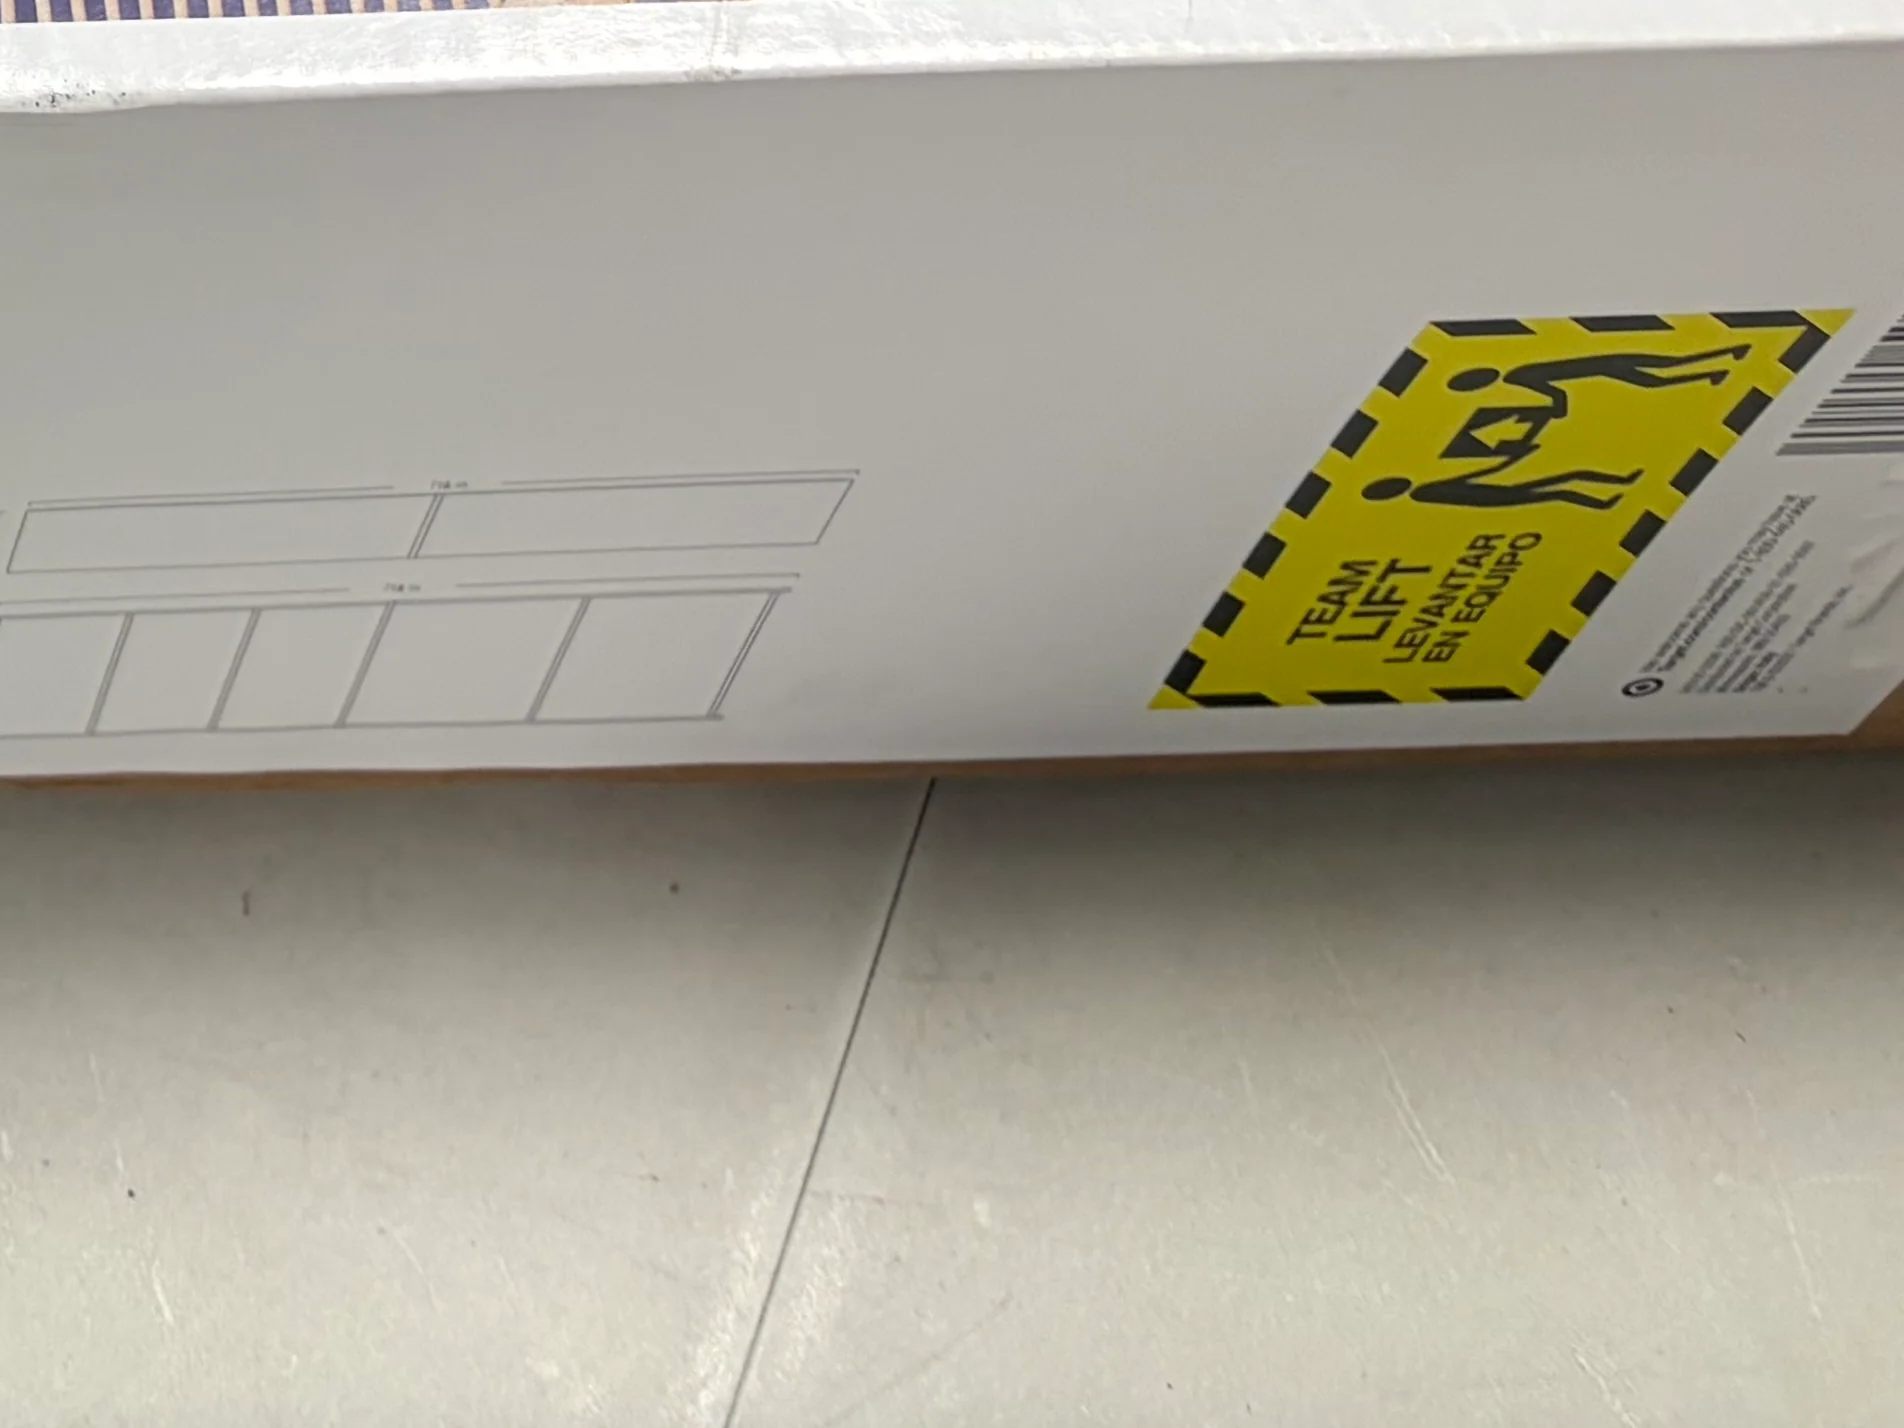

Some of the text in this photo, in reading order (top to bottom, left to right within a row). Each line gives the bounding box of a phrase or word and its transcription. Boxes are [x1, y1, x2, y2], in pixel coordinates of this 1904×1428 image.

[1286, 560, 1378, 645] TEAM
[1332, 558, 1433, 642] LIFT
[1382, 533, 1506, 664] LEVANTAR
[1422, 532, 1542, 663] EN EQUIPO
